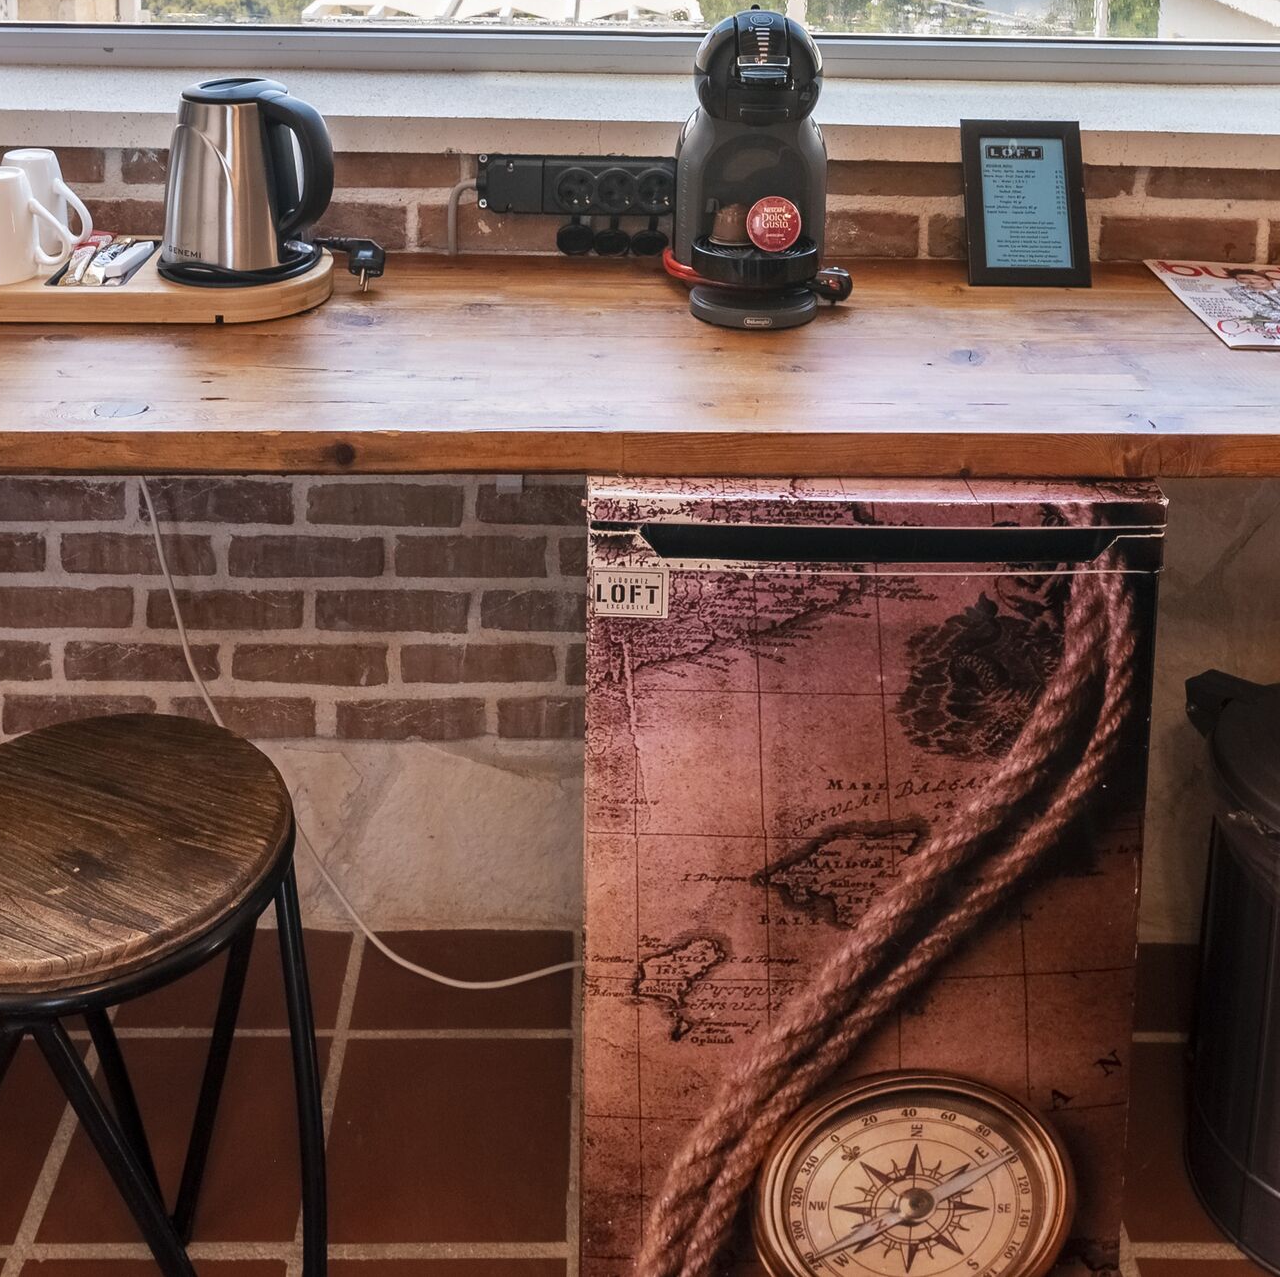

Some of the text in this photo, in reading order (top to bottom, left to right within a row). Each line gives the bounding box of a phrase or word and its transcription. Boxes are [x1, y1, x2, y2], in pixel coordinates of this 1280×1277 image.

[990, 148, 1039, 157] LOFT
[762, 213, 788, 221] Dolce
[168, 245, 202, 259] GENEMI
[607, 576, 649, 584] ÖLÜDENİZ
[596, 584, 659, 604] LOFT
[606, 603, 649, 611] EXCLUSIVE
[901, 1107, 917, 1118] 40
[940, 1111, 957, 1123] 60
[861, 1114, 878, 1127] 20
[911, 1123, 924, 1137] NE
[975, 1123, 991, 1138] 80
[830, 1133, 841, 1144] 0
[975, 1146, 989, 1160] E
[801, 1154, 820, 1177] 340
[1017, 1176, 1030, 1195] 120
[791, 1187, 803, 1207] 320
[808, 1201, 828, 1211] NW
[997, 1203, 1011, 1213] SE
[1020, 1208, 1032, 1228] 140
[791, 1220, 806, 1240] 300
[1003, 1240, 1020, 1259] 160
[832, 1255, 850, 1268] W
[969, 1260, 980, 1271] S
